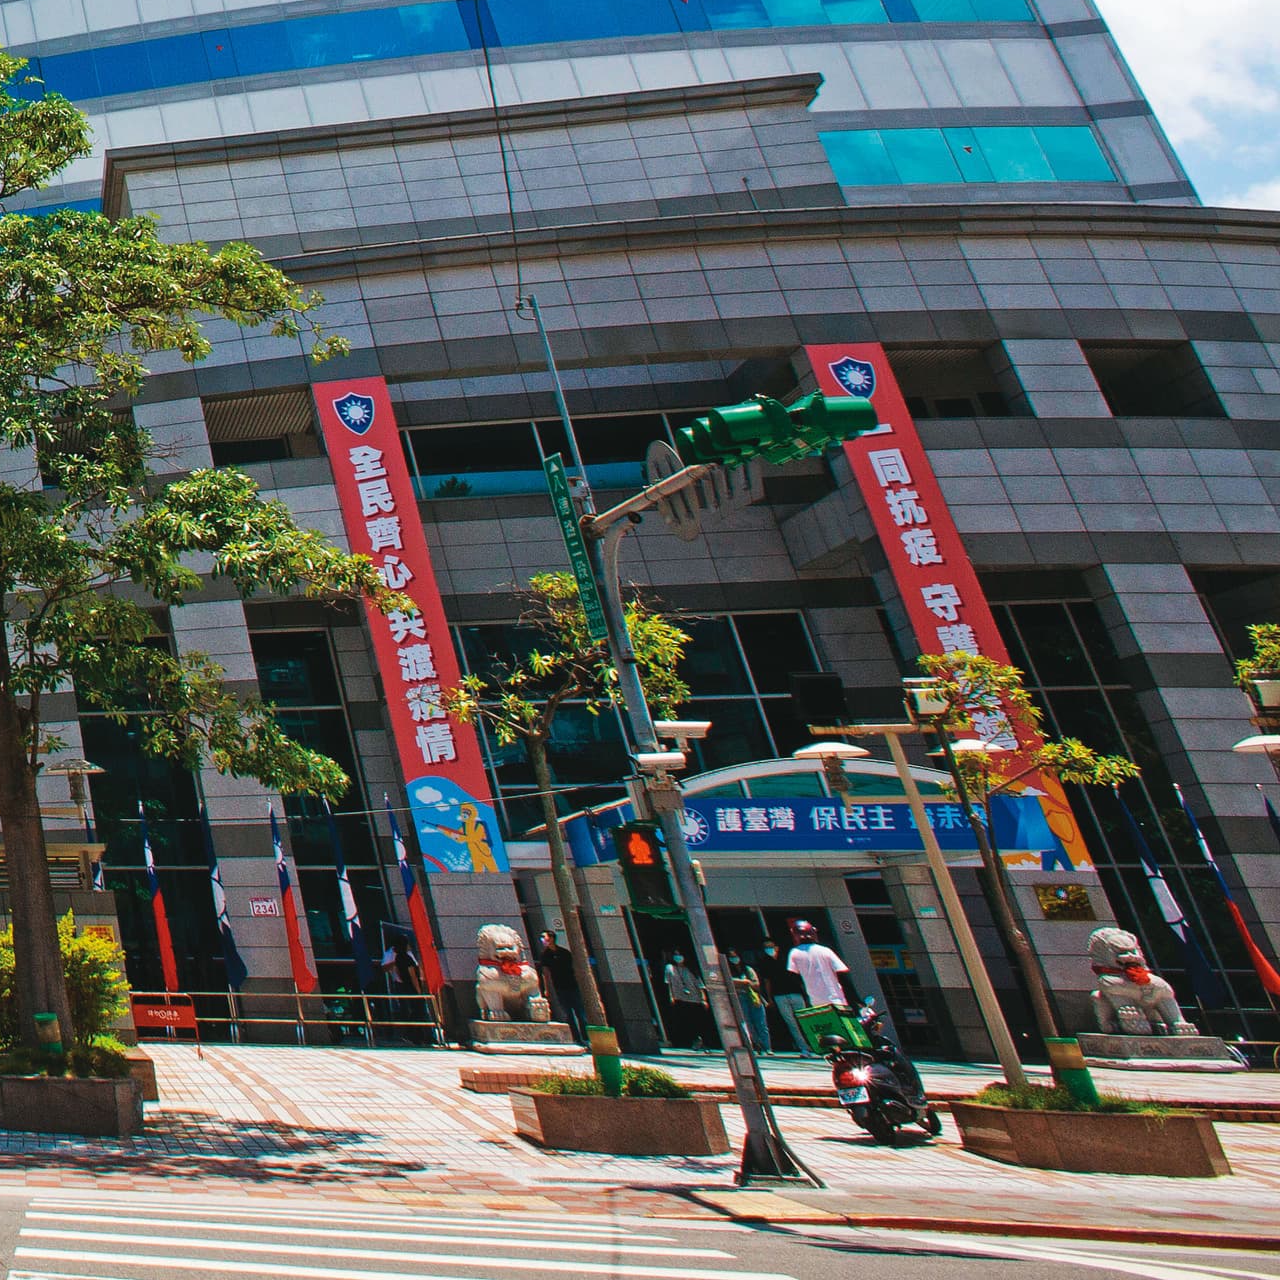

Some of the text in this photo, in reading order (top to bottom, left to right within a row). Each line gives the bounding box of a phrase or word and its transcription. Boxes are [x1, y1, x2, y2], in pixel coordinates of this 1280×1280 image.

[715, 806, 795, 833] 護臺灣
[808, 805, 897, 831] 保民主
[255, 904, 274, 914] 234
